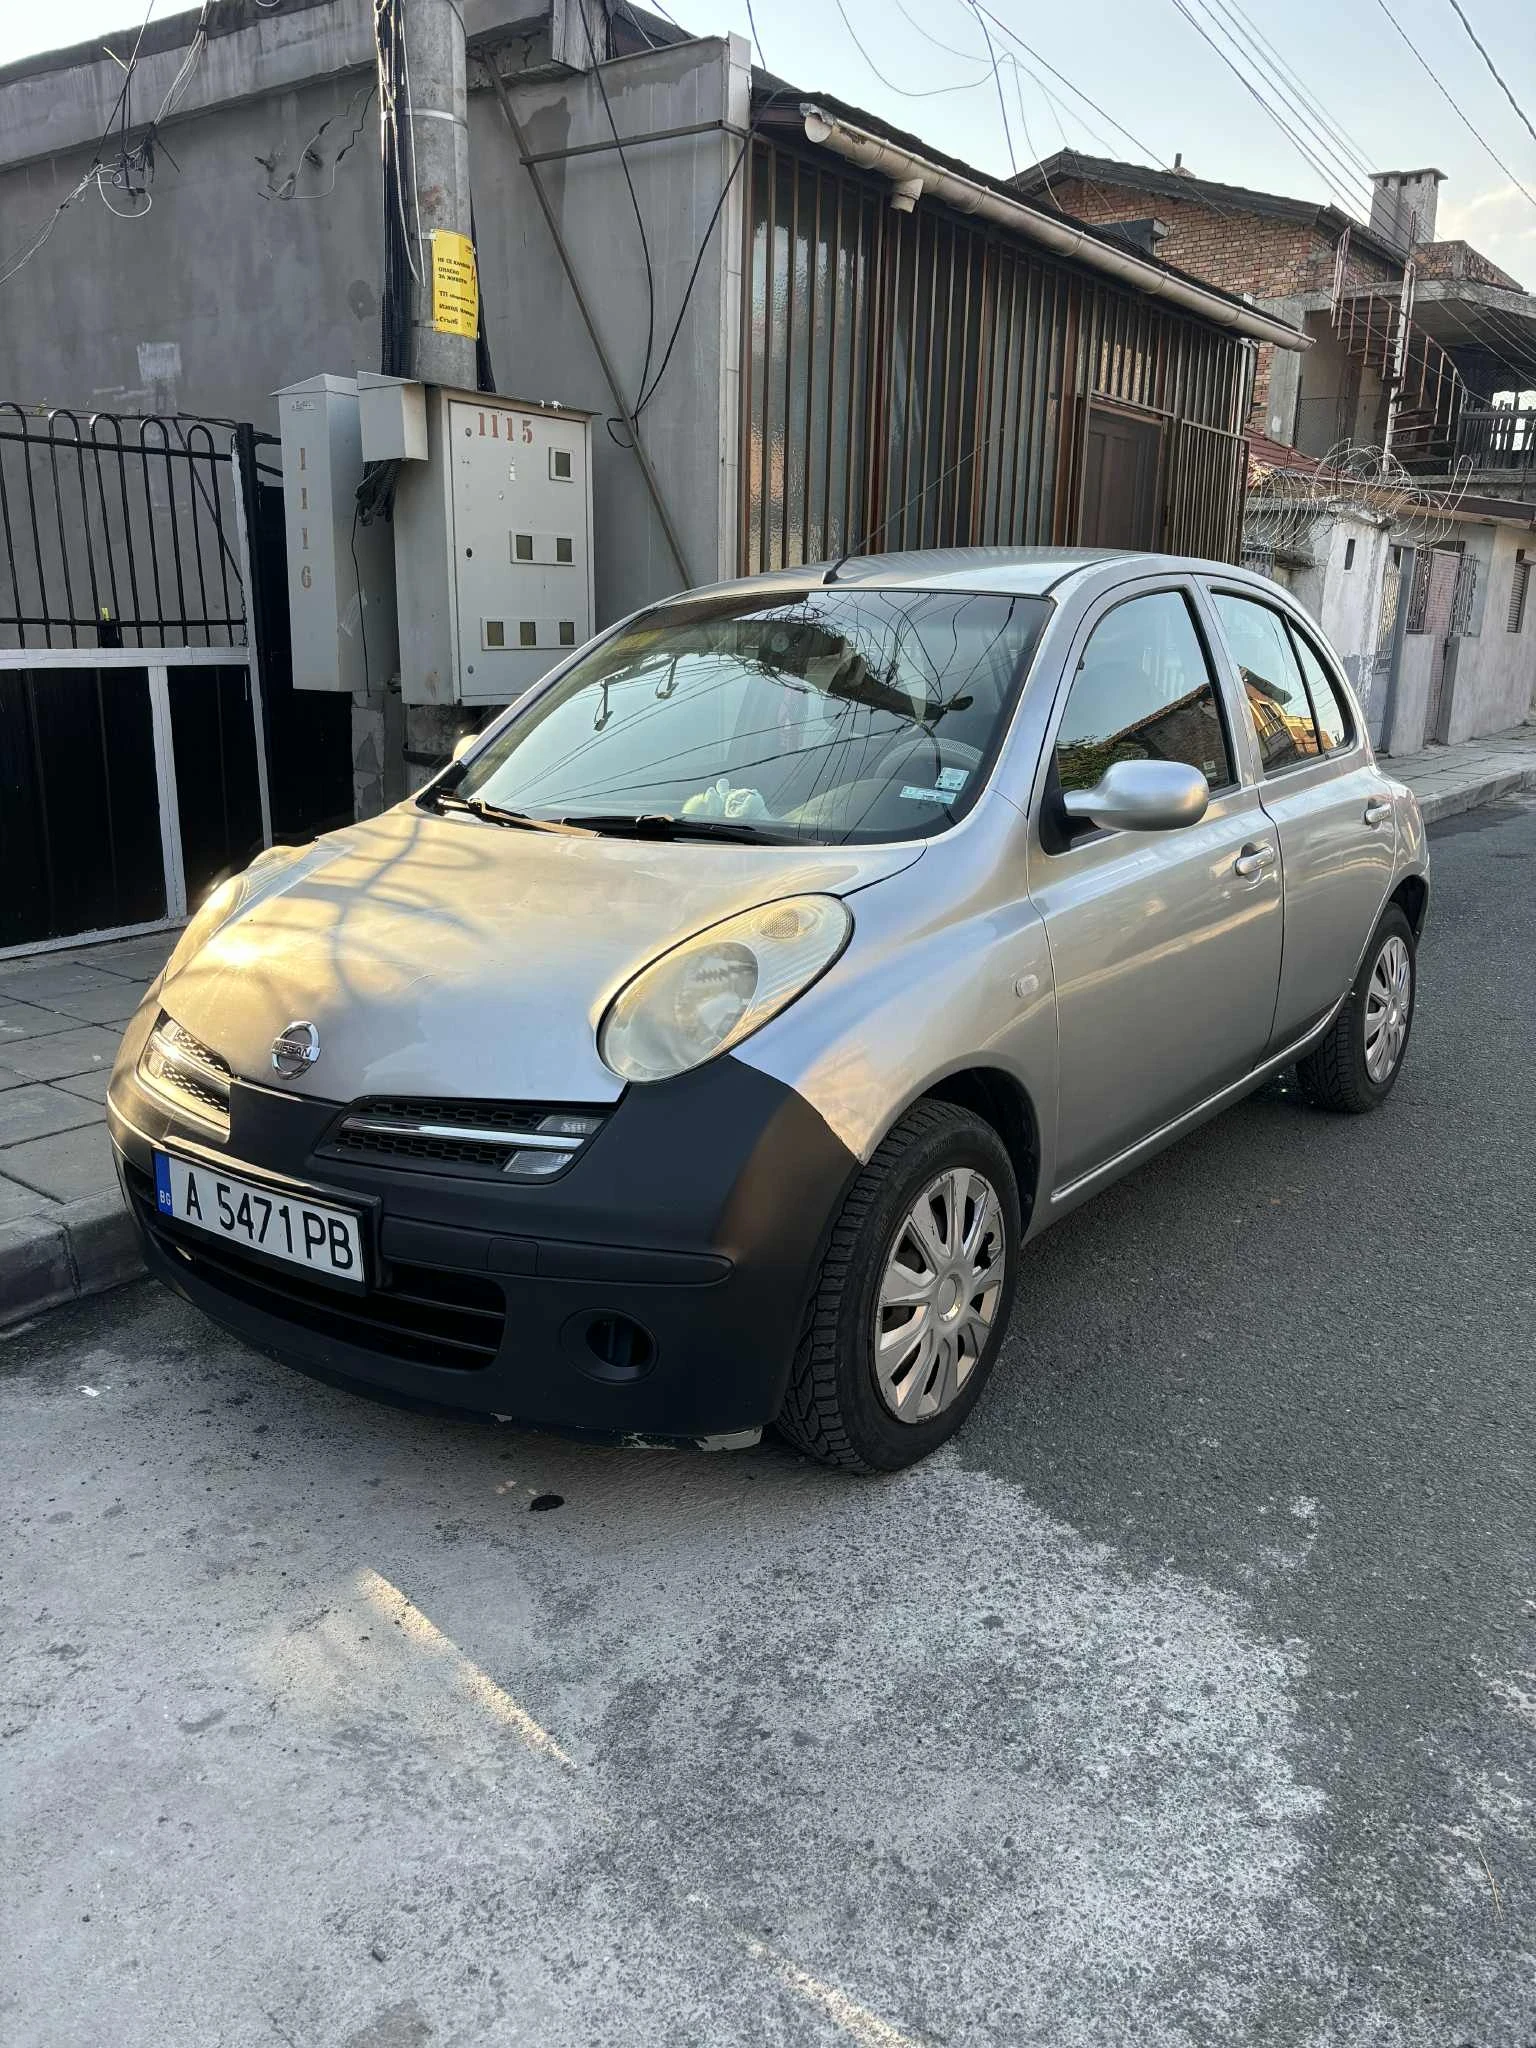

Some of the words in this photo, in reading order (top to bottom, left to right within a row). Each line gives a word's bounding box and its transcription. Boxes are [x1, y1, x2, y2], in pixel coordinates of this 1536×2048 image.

[478, 412, 533, 444] 1115
[159, 1190, 171, 1206] BG
[186, 1172, 202, 1220] A
[217, 1182, 294, 1254] 5471
[302, 1210, 353, 1270] PB
